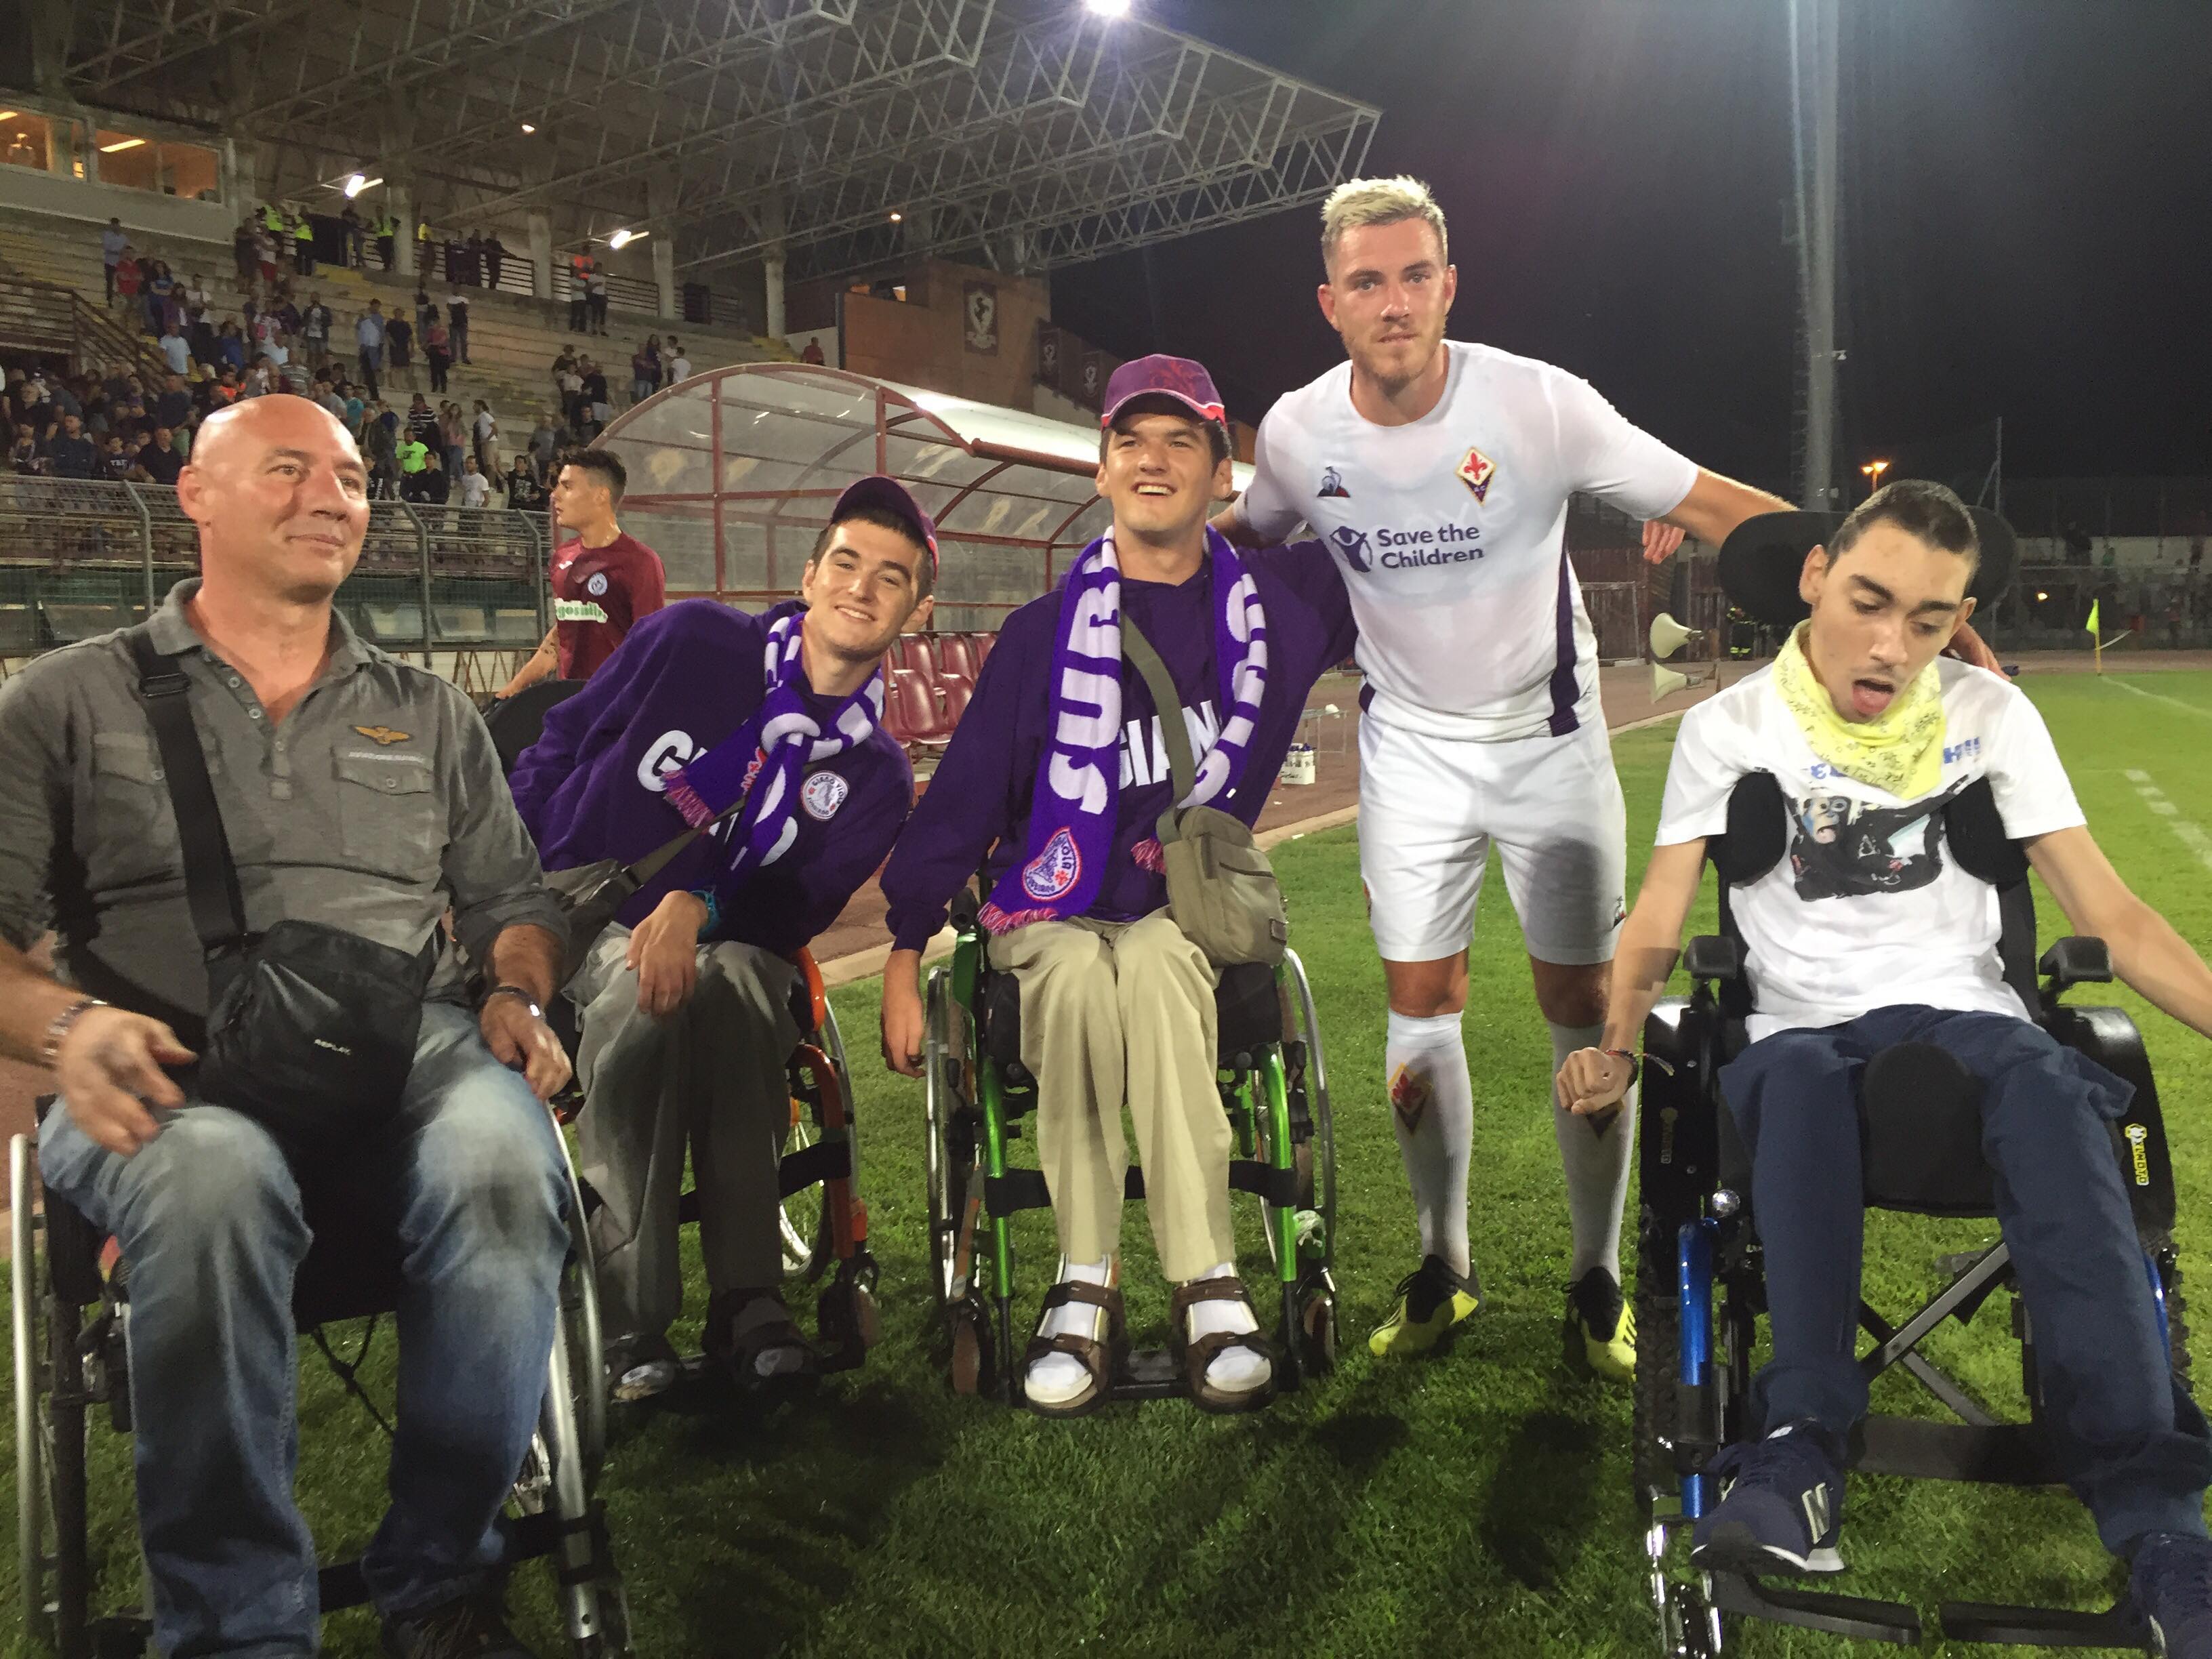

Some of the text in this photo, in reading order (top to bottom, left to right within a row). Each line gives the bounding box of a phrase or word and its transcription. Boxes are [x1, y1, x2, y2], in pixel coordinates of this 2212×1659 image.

[1377, 523, 1480, 547] Save the
[1381, 548, 1485, 569] Children
